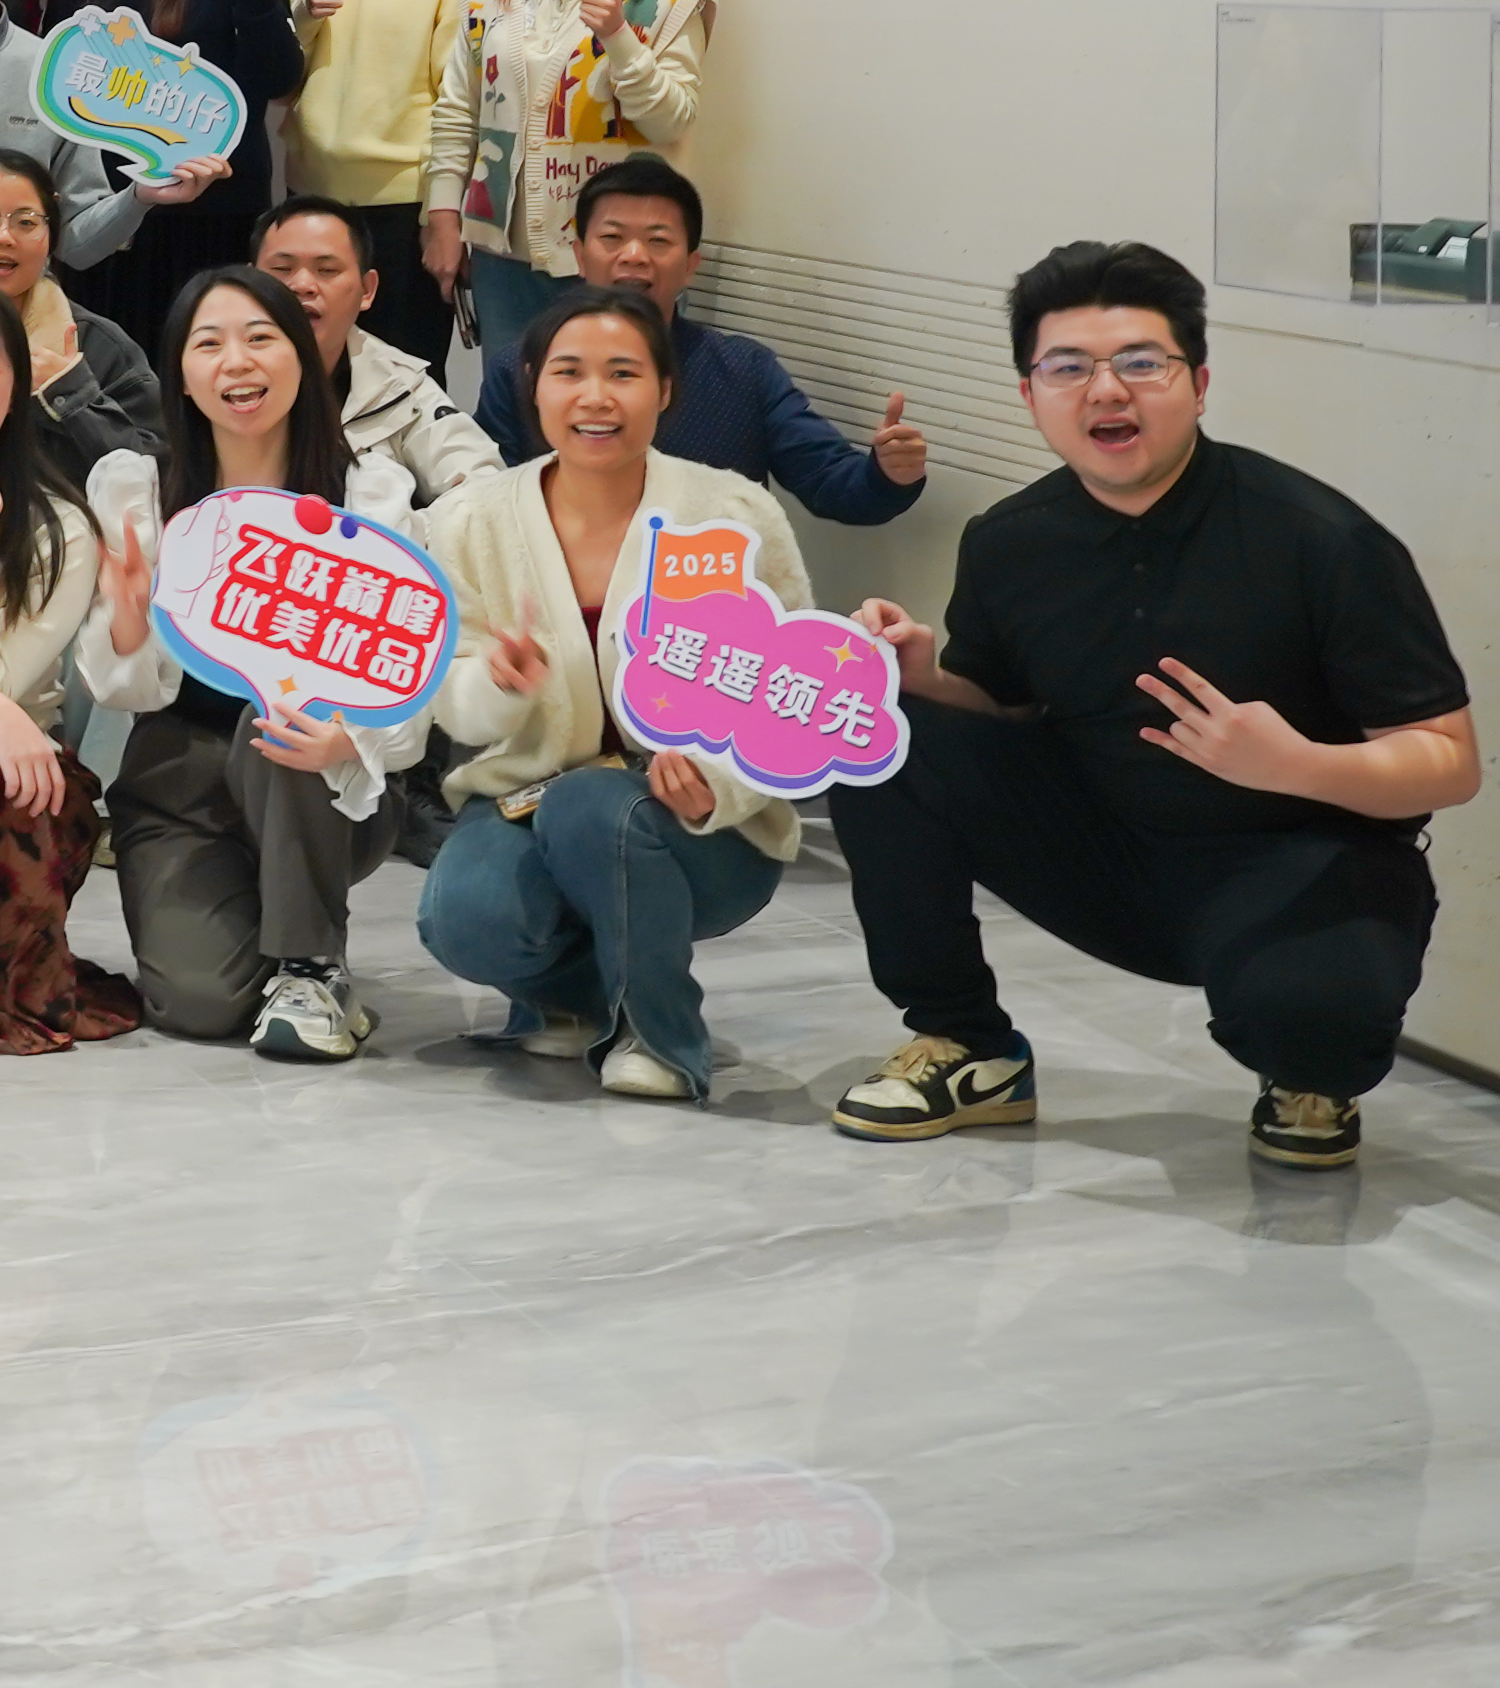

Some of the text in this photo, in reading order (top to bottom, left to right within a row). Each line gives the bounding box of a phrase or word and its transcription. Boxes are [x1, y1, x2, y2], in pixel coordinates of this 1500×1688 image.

[65, 50, 230, 135] 最帅的仔
[233, 525, 442, 638] 飞跃巅峰
[664, 548, 738, 579] 2025
[216, 584, 424, 692] 优美优品
[648, 621, 878, 750] 遥遥领先
